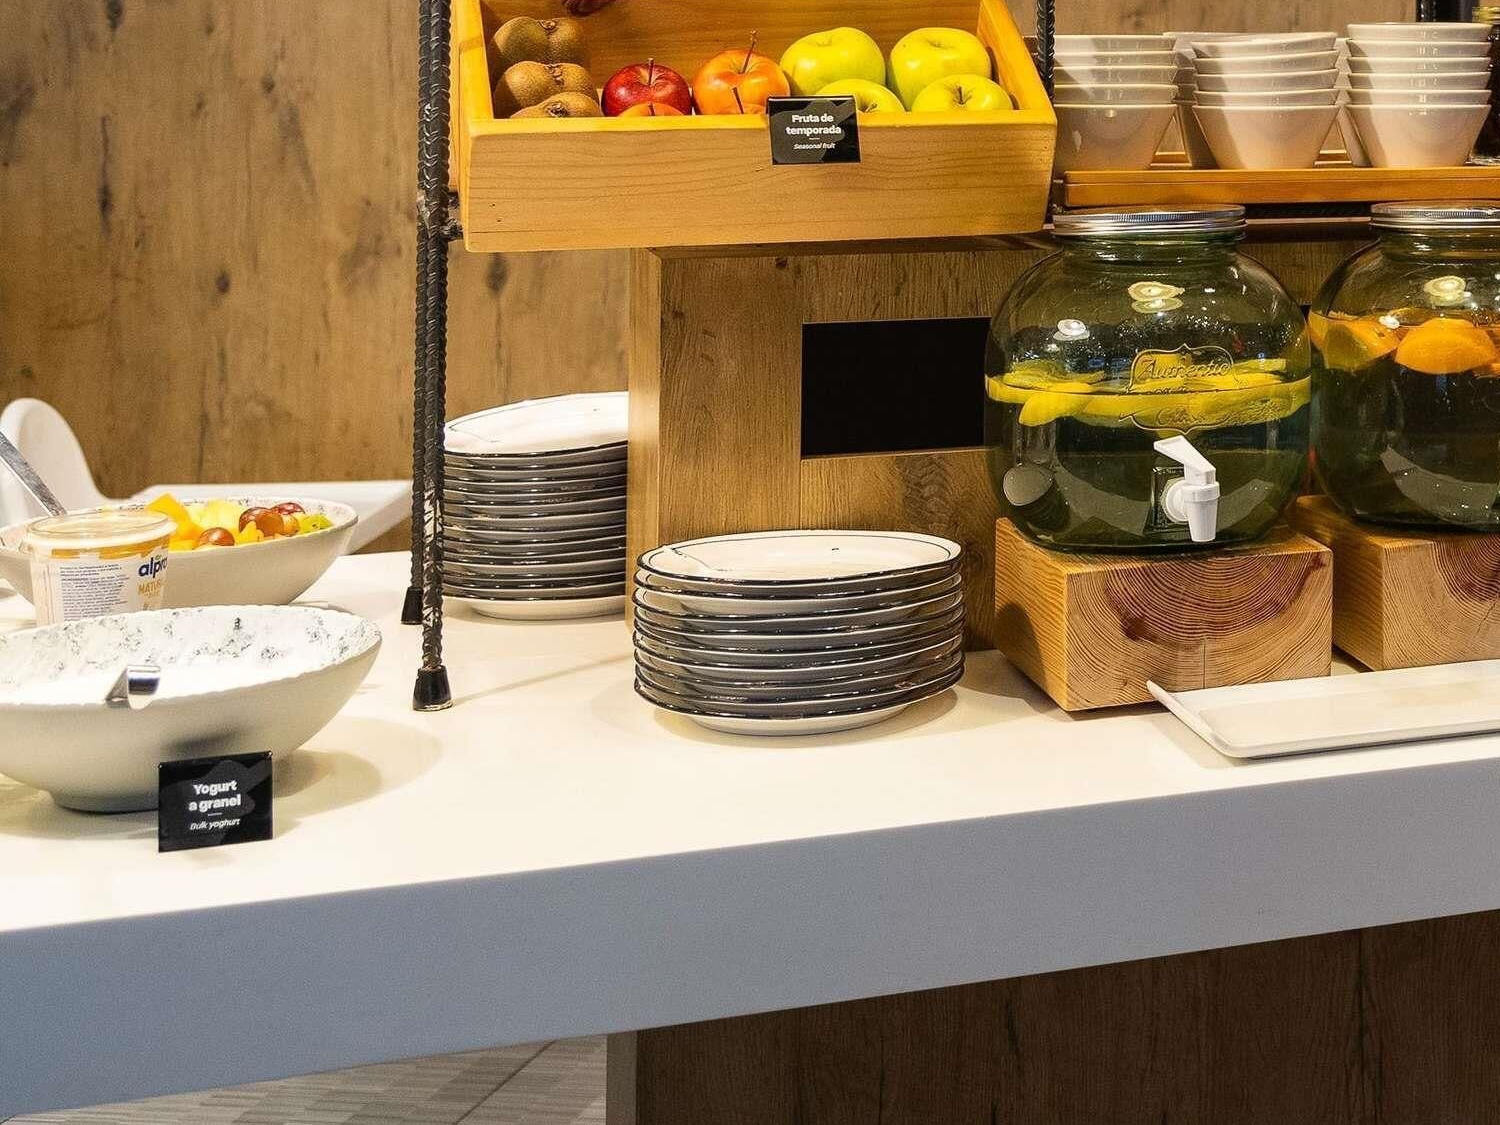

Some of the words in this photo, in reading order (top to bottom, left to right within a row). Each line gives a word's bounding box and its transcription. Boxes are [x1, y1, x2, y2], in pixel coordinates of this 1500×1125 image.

[791, 114, 820, 123] Fruta
[820, 113, 834, 123] de
[785, 125, 842, 136] temporada
[193, 780, 237, 796] Yogurt
[188, 801, 197, 811] a
[199, 794, 241, 812] granel
